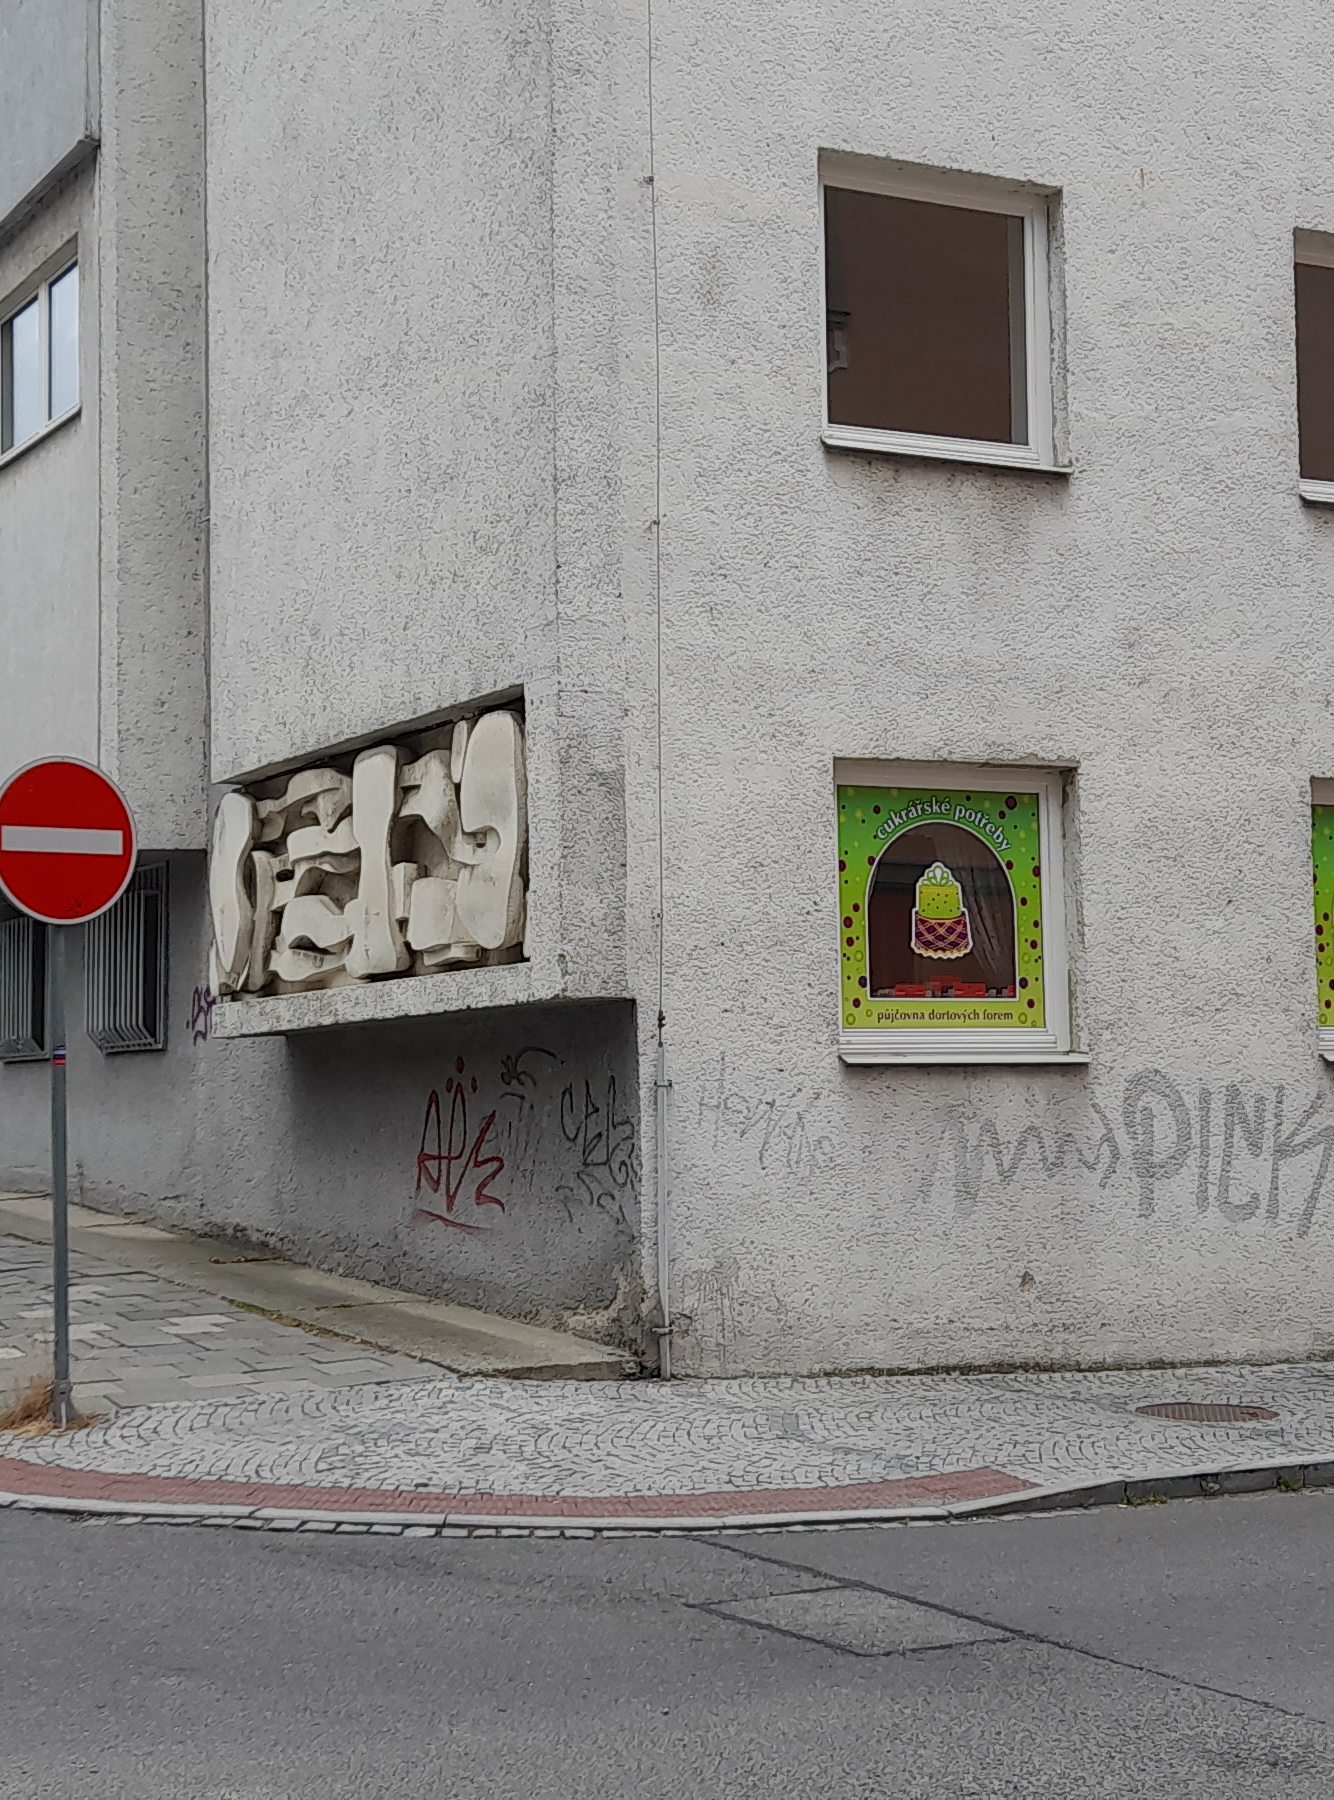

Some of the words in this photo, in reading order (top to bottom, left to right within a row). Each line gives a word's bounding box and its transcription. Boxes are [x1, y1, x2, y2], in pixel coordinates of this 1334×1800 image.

[877, 796, 951, 839] cukrářské
[954, 804, 1012, 851] potřeby
[877, 1008, 925, 1023] půjčovna
[928, 1008, 980, 1023] dortových
[982, 1008, 1014, 1021] forem
